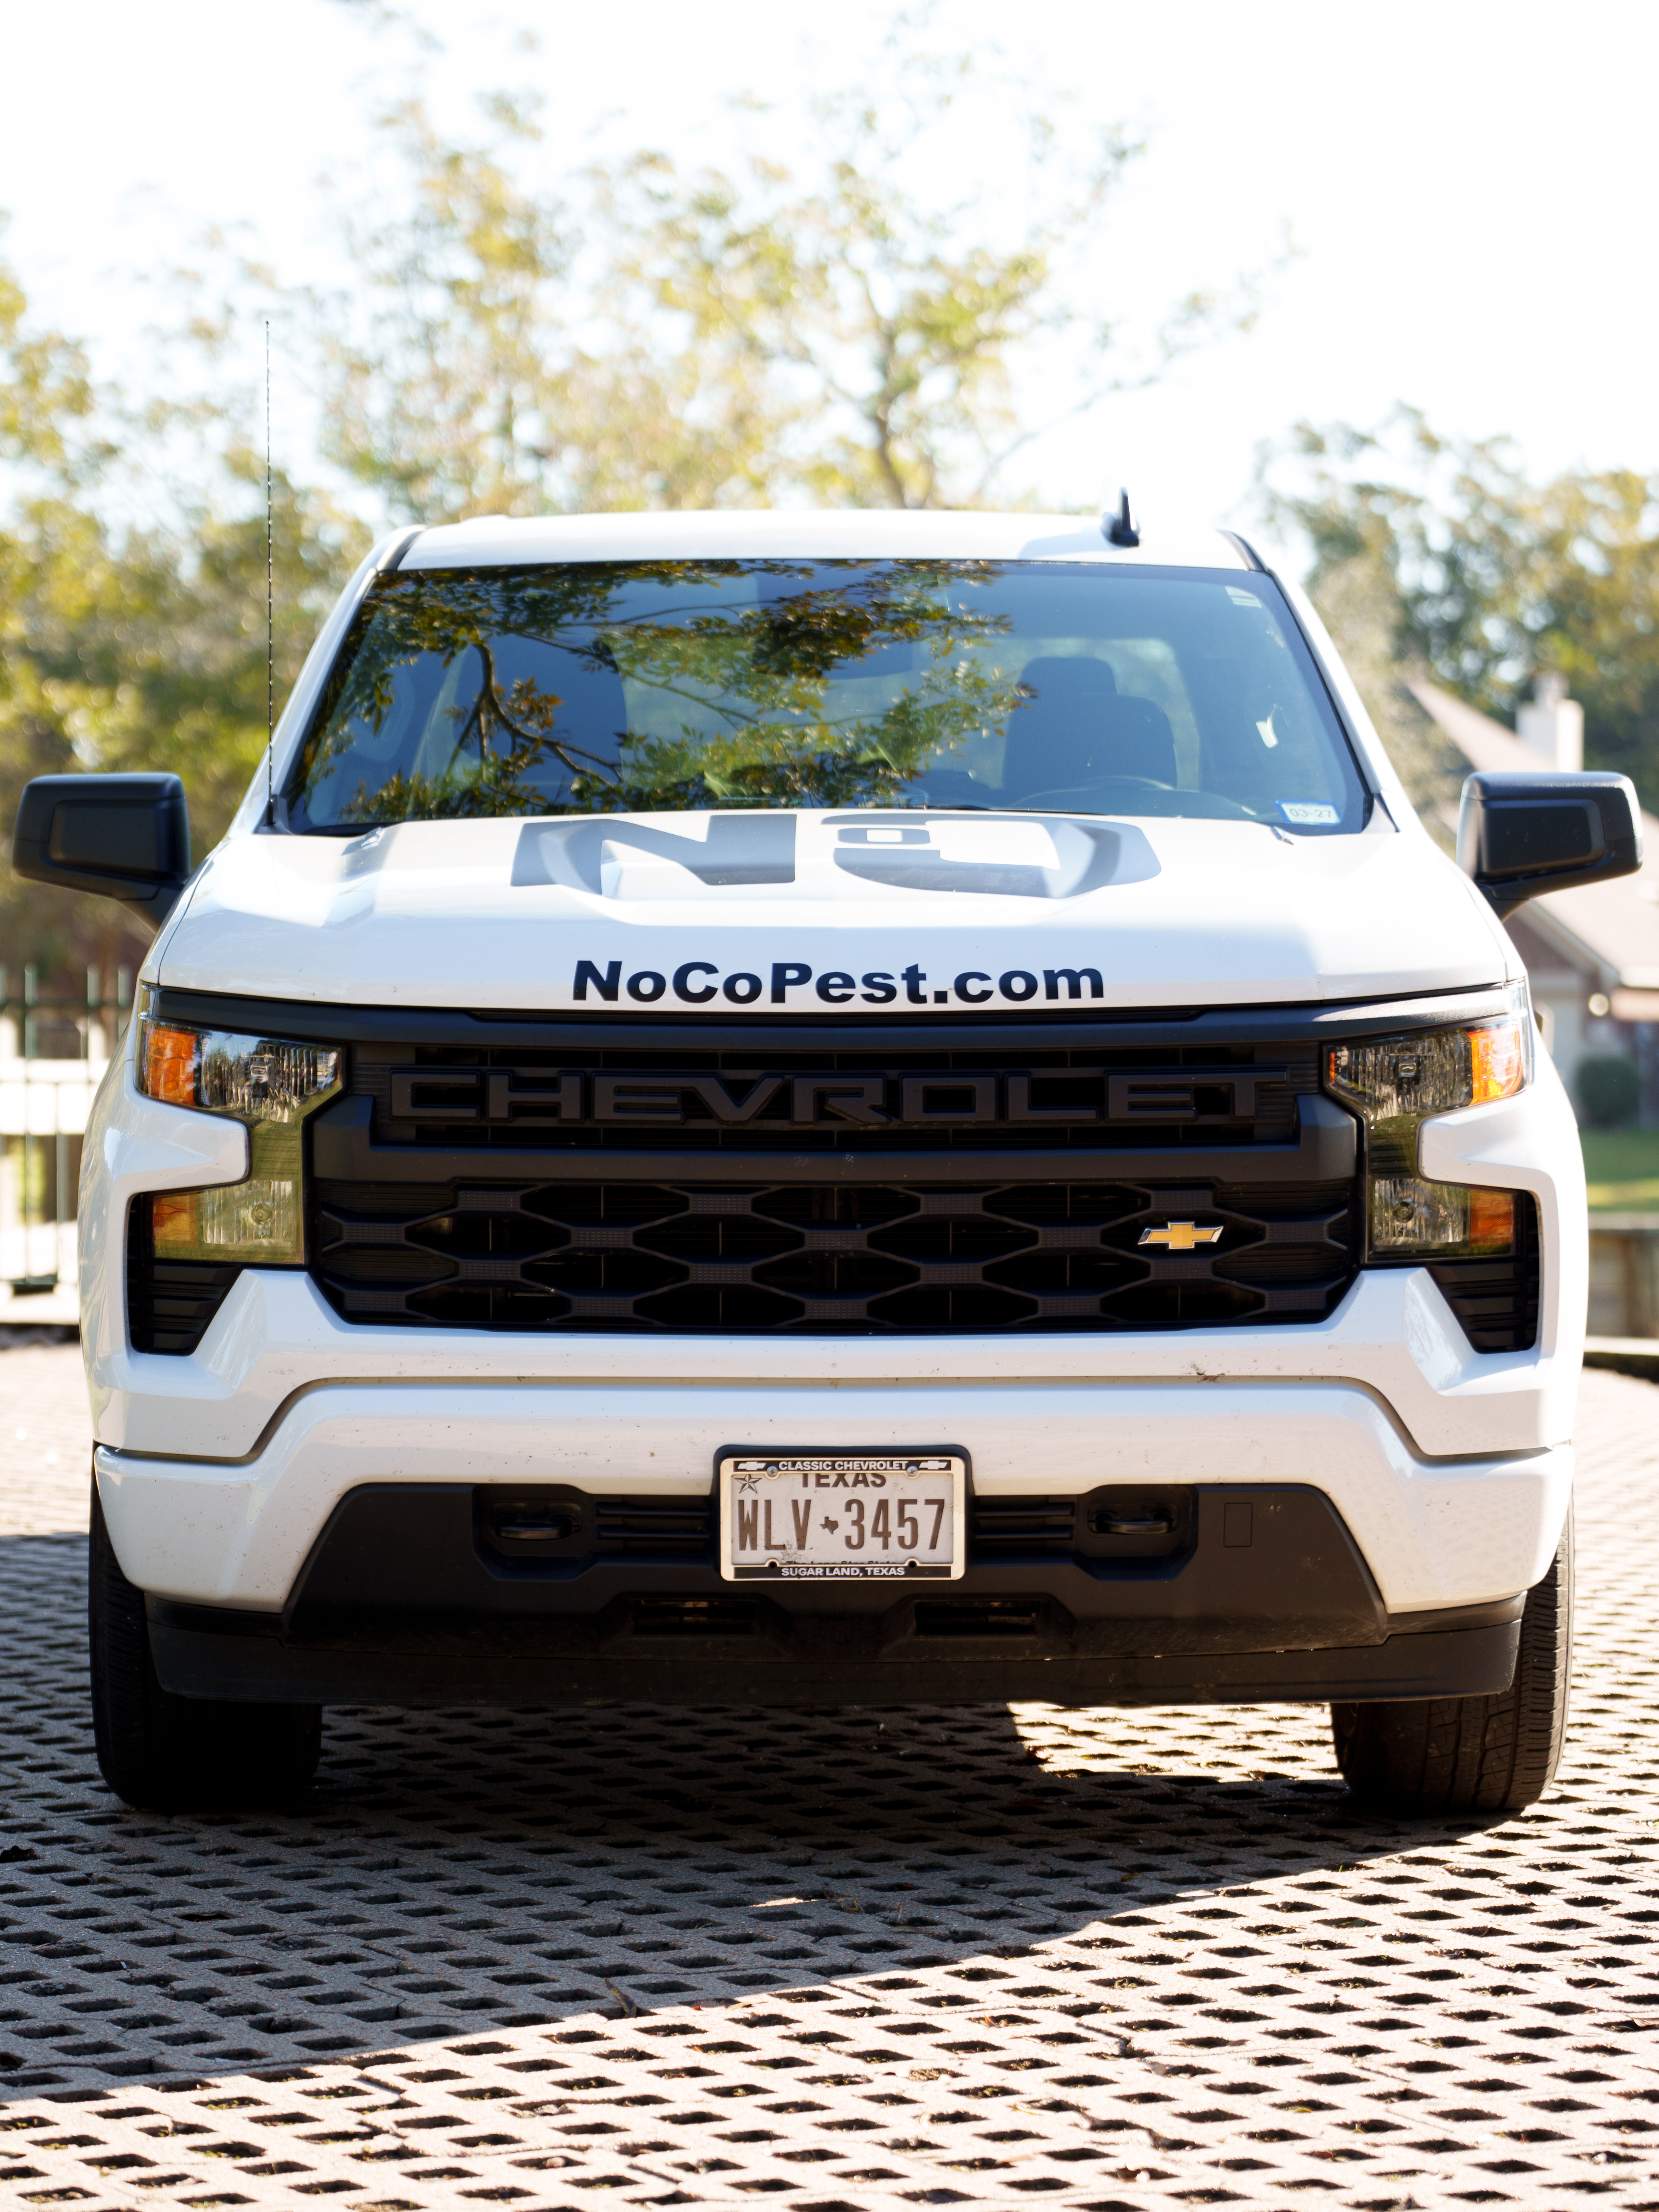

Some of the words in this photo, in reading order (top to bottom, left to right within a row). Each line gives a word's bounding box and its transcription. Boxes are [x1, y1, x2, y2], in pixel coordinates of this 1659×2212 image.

[572, 960, 1104, 1004] NoCoPest.com
[390, 1071, 1288, 1122] CHEVROLET
[779, 1461, 832, 1470] CLASSIC
[835, 1461, 908, 1470] CHEVROLET
[737, 1500, 811, 1551] WLV
[844, 1499, 945, 1550] 3457
[781, 1567, 823, 1576] SUGAR
[826, 1567, 863, 1577] LAND,
[865, 1567, 905, 1576] TEXAS
